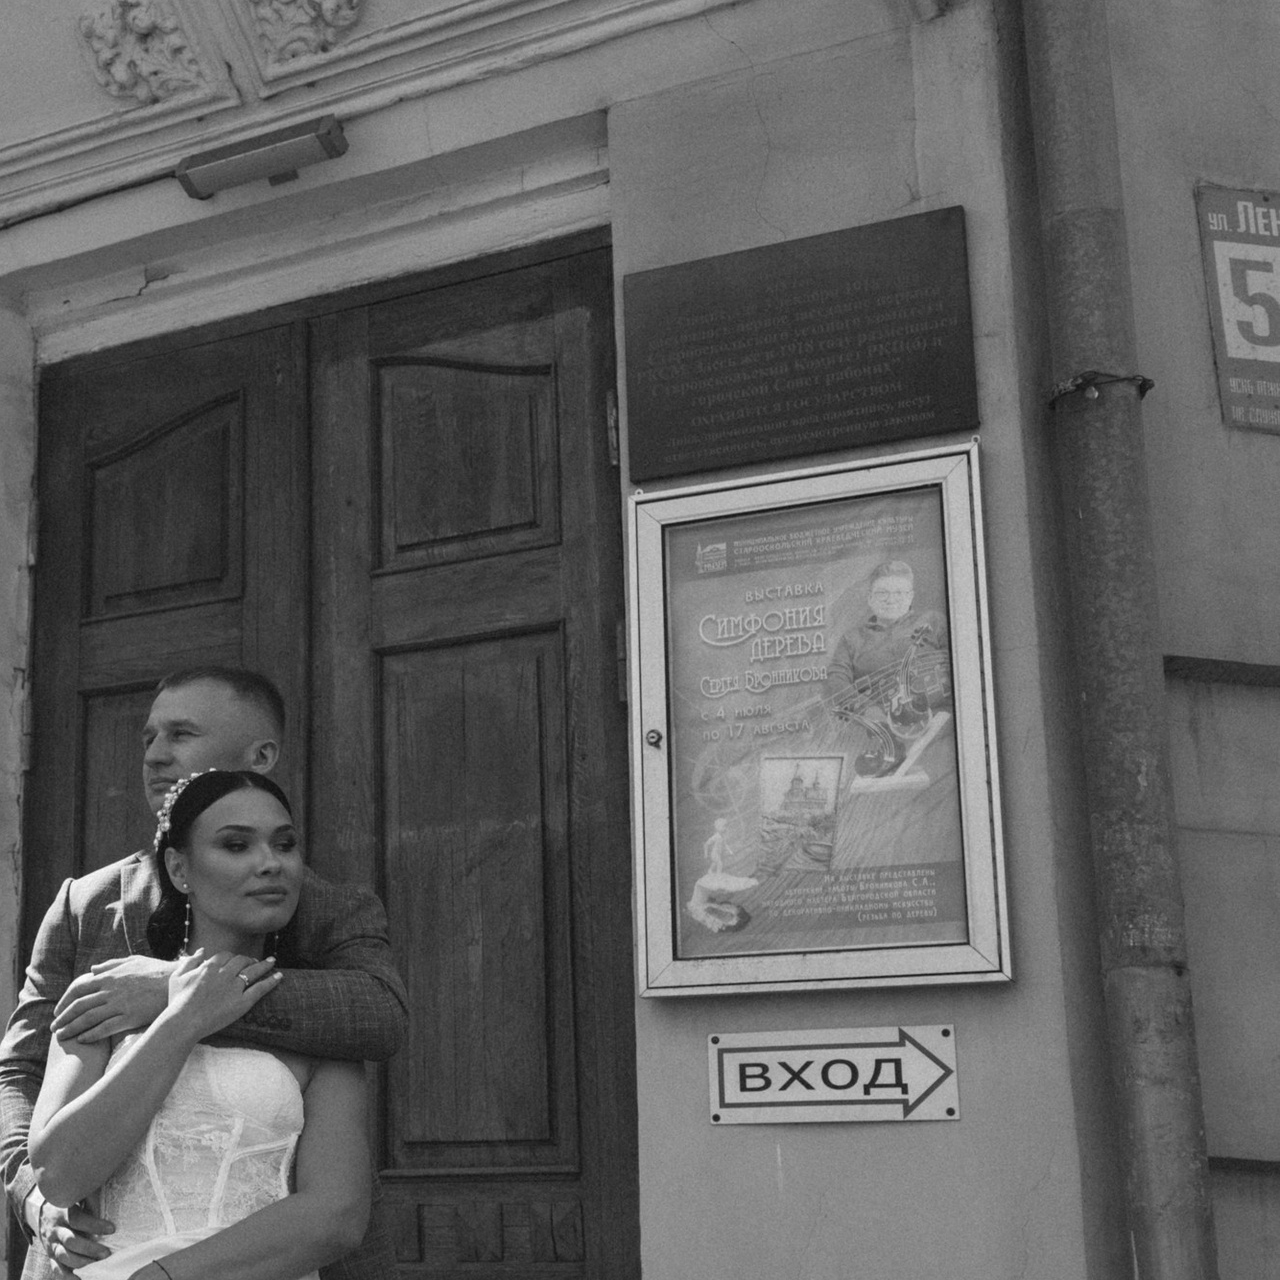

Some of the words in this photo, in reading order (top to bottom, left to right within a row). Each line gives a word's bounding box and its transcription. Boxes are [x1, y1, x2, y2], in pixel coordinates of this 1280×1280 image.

[1208, 212, 1233, 232] ул.
[1229, 257, 1280, 347] 5
[733, 537, 813, 555] СТАРООСКОЛЬСКИЙ
[816, 527, 882, 544] КРАЕВЕДЧЕСКИЙ
[745, 581, 824, 602] ВЫСТАВКА
[750, 631, 827, 663] ДЕРЕВА
[716, 705, 725, 718] 4
[728, 722, 744, 737] 17
[738, 1058, 909, 1096] ВХОД
